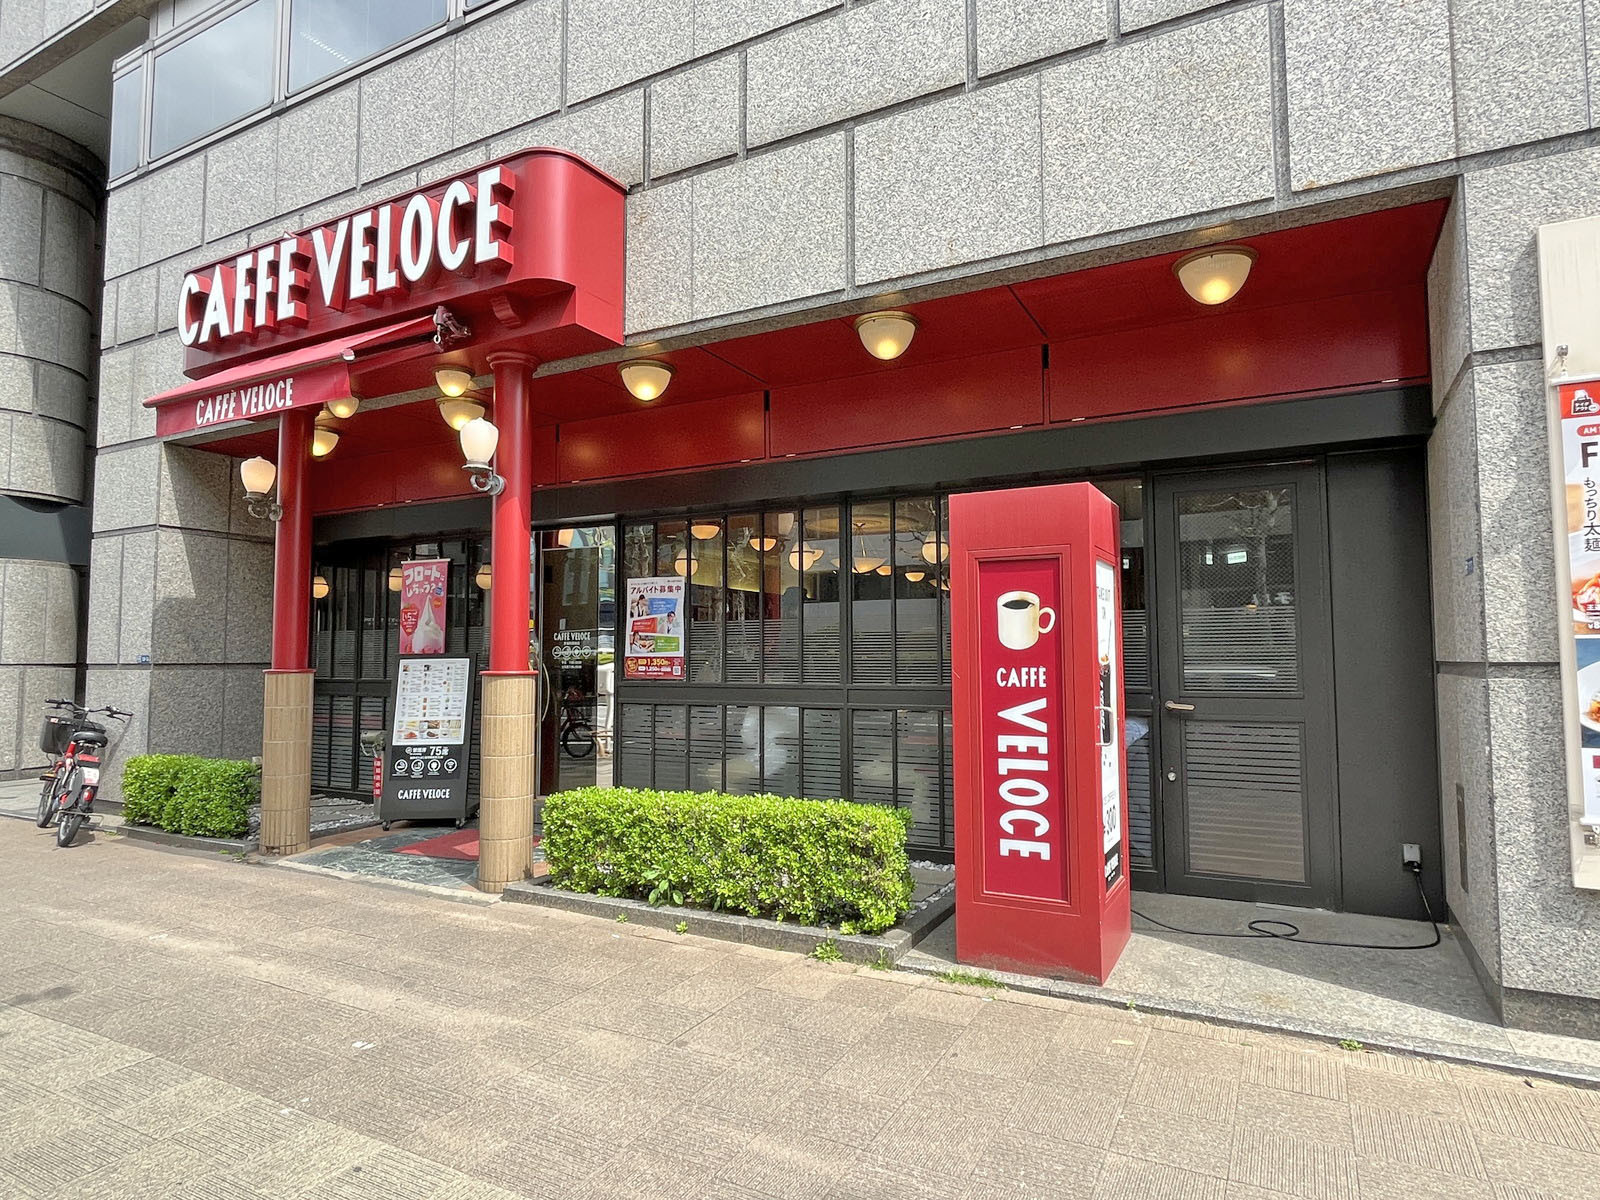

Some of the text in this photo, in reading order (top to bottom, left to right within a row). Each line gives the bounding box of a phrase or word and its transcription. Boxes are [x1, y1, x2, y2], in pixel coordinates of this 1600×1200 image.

[311, 165, 501, 307] VELOCE
[239, 377, 294, 416] VELOCE
[570, 631, 591, 641] VELOCE
[429, 746, 443, 756] 75
[997, 697, 1051, 861] VELOCE
[422, 788, 451, 800] VELOCE
